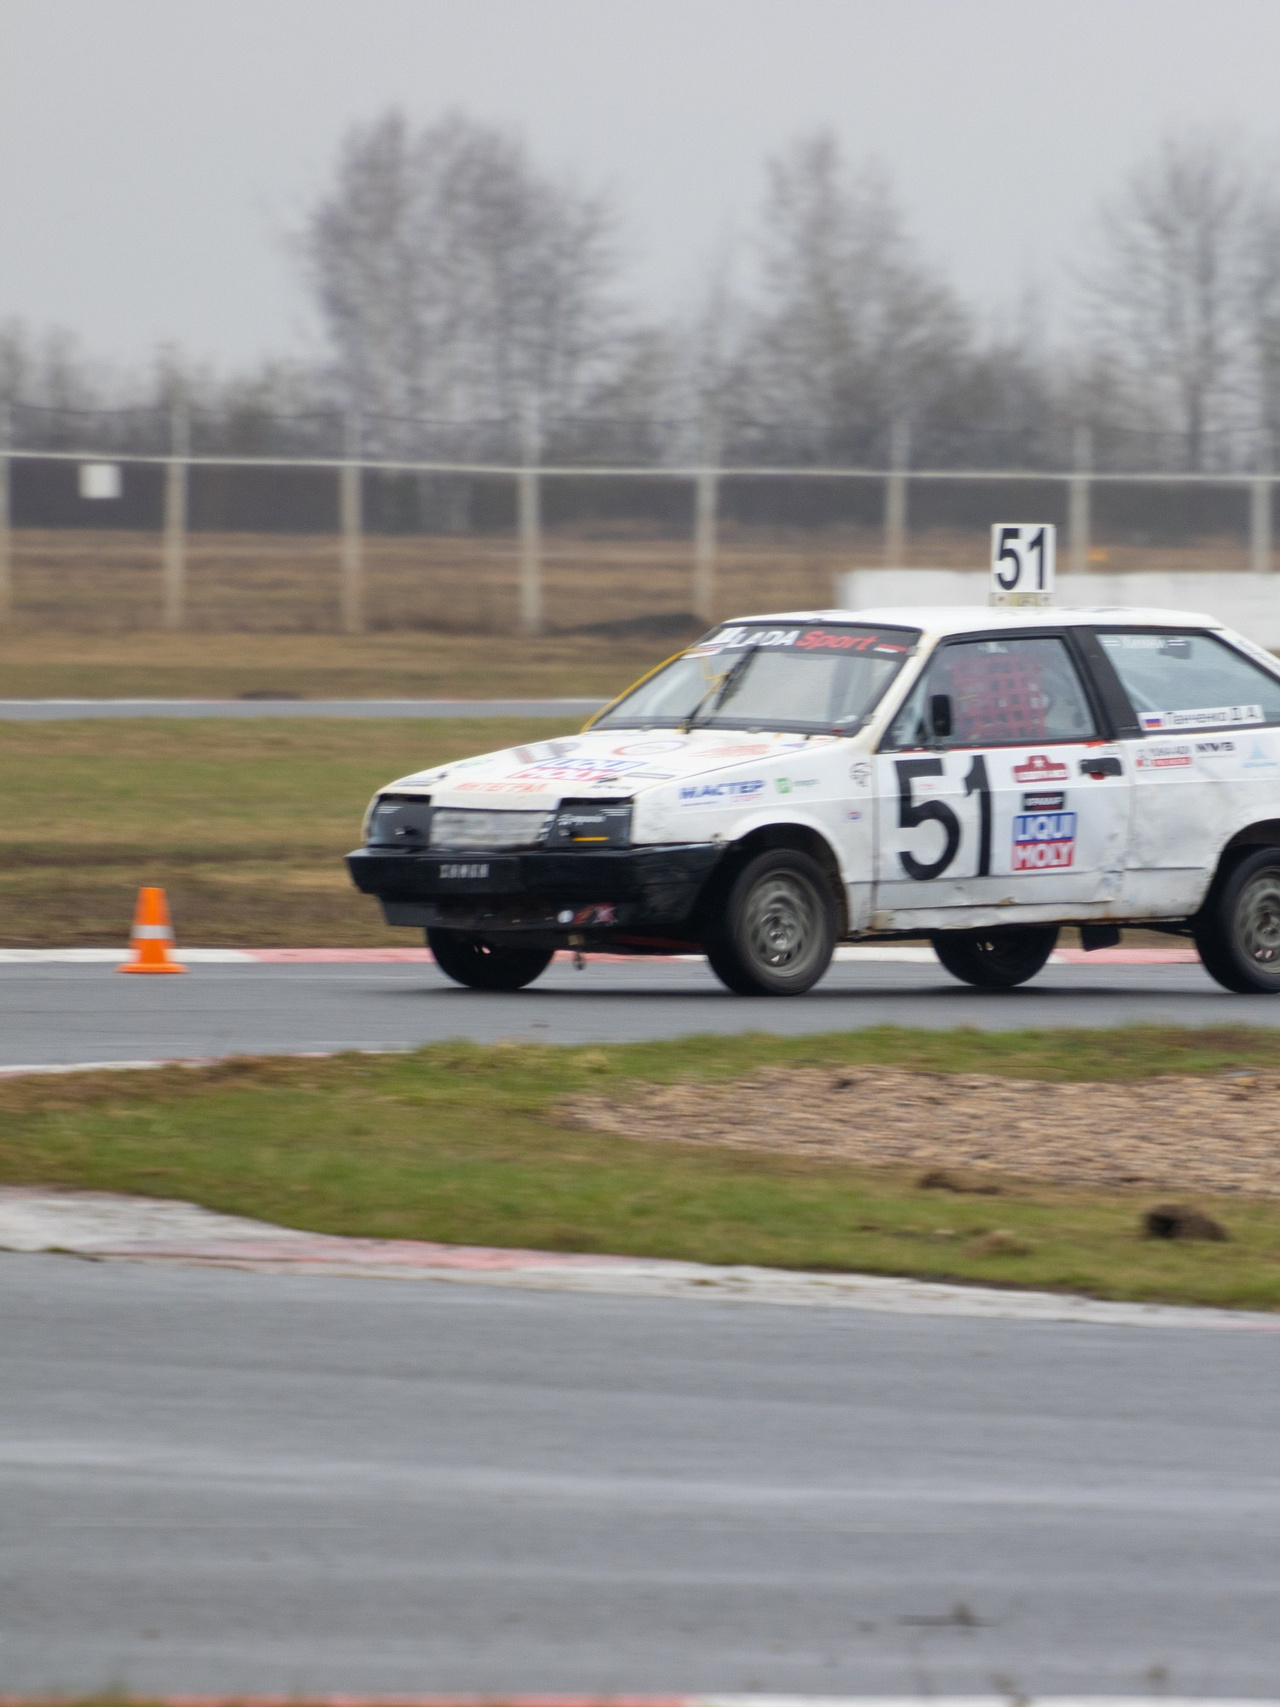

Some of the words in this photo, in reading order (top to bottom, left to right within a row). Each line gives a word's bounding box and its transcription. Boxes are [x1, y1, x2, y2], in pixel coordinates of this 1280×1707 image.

[997, 527, 1045, 591] 51
[725, 630, 800, 648] LADA
[796, 630, 878, 651] Sport
[895, 755, 992, 880] 51
[1016, 815, 1074, 841] LIQUI
[1015, 843, 1073, 868] MOLY
